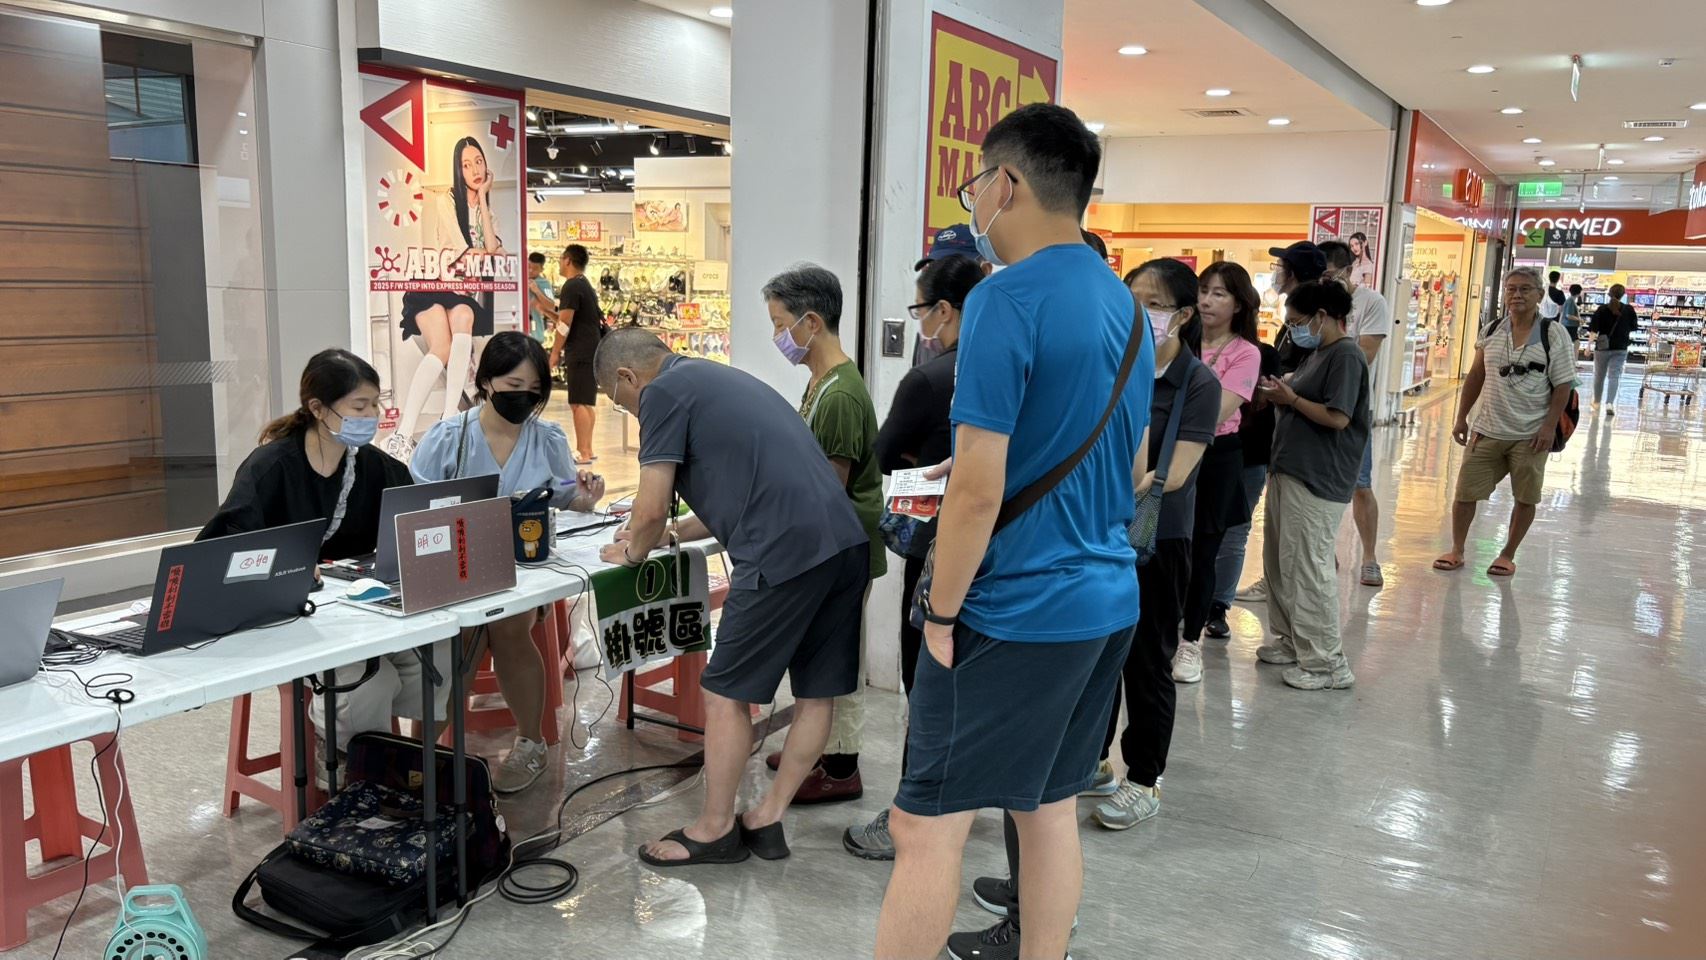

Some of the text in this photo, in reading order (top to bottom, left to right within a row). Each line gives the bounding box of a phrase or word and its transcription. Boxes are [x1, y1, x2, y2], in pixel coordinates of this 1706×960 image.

[940, 60, 1011, 146] ABC
[937, 146, 982, 198] MA
[1520, 217, 1622, 236] COSMED
[404, 247, 518, 282] ABC-MART
[702, 272, 719, 280] crocs
[373, 281, 516, 290] 2025 F/W STEP INTO EXPRESS MODE THIS SEASON
[604, 602, 704, 669] 掛號區
